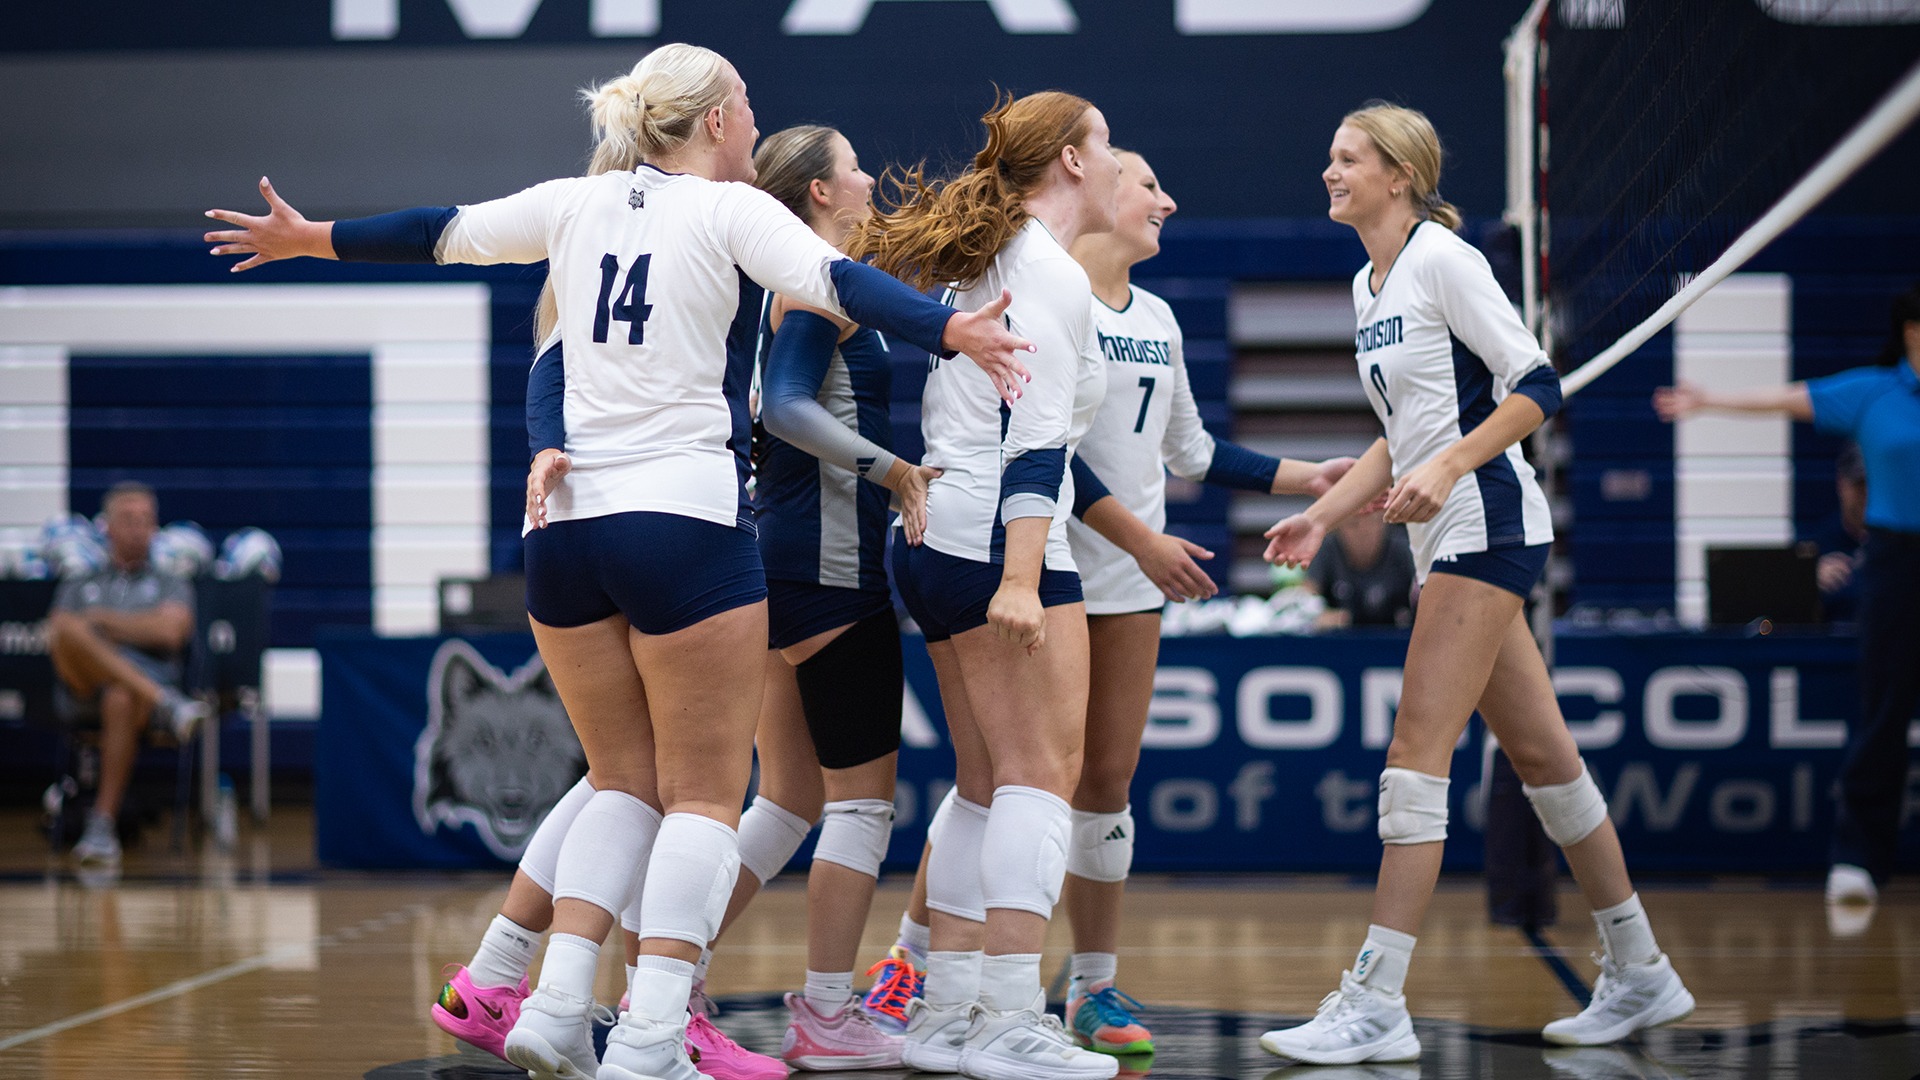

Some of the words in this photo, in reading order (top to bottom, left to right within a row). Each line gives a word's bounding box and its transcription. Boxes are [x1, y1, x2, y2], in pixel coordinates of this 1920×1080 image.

[593, 253, 653, 345] 14
[1096, 326, 1171, 366] MADISO
[1355, 315, 1403, 354] ADISON
[1134, 376, 1156, 434] 7
[1550, 665, 1920, 750] COL
[1149, 761, 1276, 832] of
[1598, 760, 1845, 833] Wol
